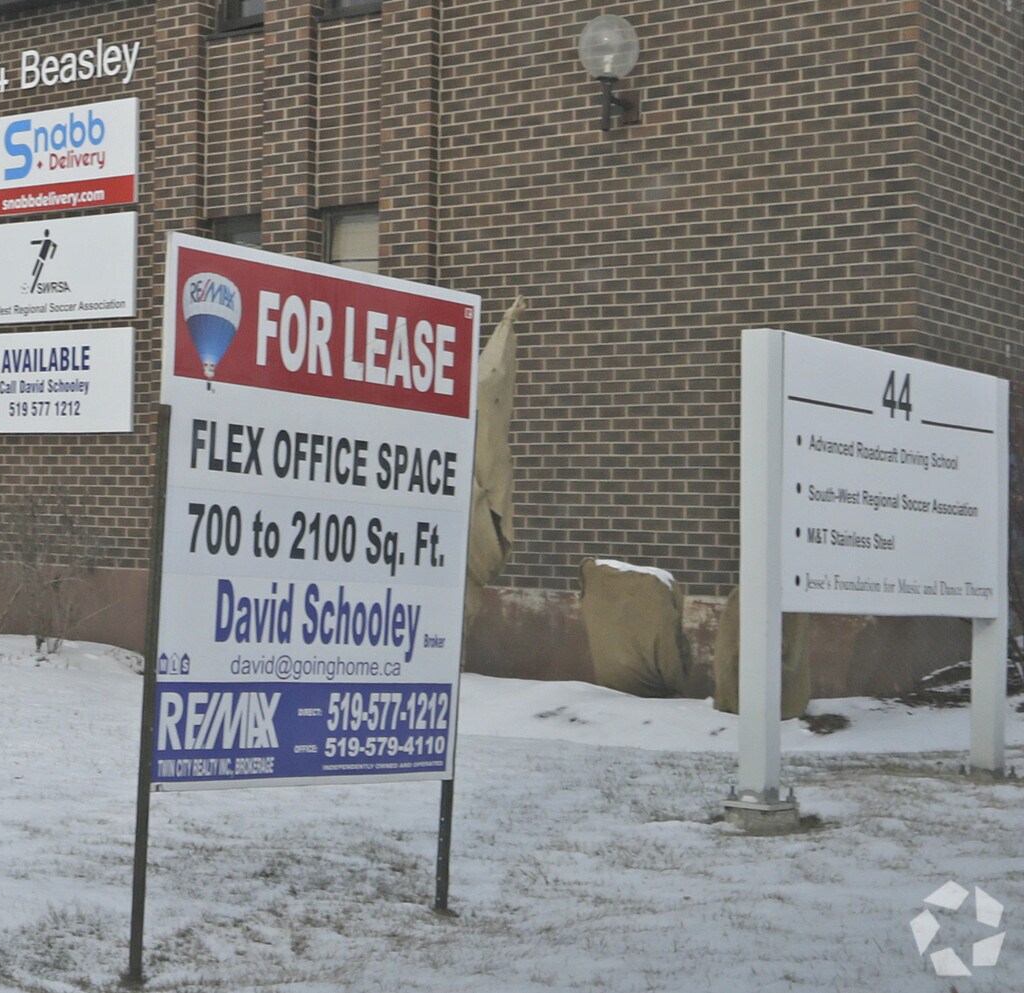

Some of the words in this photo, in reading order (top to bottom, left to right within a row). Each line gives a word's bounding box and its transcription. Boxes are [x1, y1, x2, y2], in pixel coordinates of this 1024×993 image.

[21, 38, 140, 89] Beasley
[4, 109, 105, 181] Snabb
[49, 150, 106, 170] Delivery
[2, 189, 105, 210] snabbdelivery.com
[37, 281, 71, 294] SWRSA
[13, 302, 47, 316] Regional
[49, 301, 76, 313] Soccer
[78, 299, 126, 312] Association
[256, 290, 333, 377] FOR
[344, 306, 456, 396] LEASE
[1, 346, 91, 373] AVAILABLE
[0, 379, 17, 394] Call
[20, 379, 44, 393] David
[47, 378, 90, 395] Schooley
[882, 370, 912, 421] 44
[9, 401, 28, 417] 519
[31, 401, 51, 416] 577
[55, 400, 81, 416] 1212
[190, 419, 264, 476] FLEX
[273, 429, 368, 487] OFFICE
[376, 442, 457, 496] SPACE
[808, 434, 854, 458] Advanced
[856, 441, 898, 464] Roadcraft
[900, 447, 929, 470] Driving
[931, 452, 959, 470] School
[808, 484, 860, 505] South-West
[862, 490, 900, 511] Regional
[901, 494, 931, 511] Soccer
[932, 498, 979, 517] Association
[188, 503, 241, 556] 700
[253, 509, 280, 558] to
[289, 511, 357, 563] 2100
[366, 517, 405, 577] Sq.
[414, 521, 444, 567] Ft.
[807, 527, 828, 544] M&T
[830, 529, 871, 549] Stainless
[873, 533, 895, 550] Steel
[834, 575, 880, 593] Foundation
[883, 577, 897, 593] for
[898, 578, 921, 594] Music
[923, 580, 938, 595] and
[940, 581, 963, 596] Dance
[965, 582, 993, 600] Therapy
[214, 579, 295, 644] David
[302, 583, 421, 663] Schooley
[424, 634, 446, 648] Broker
[230, 654, 401, 680] david@goinghome.ca
[157, 692, 282, 751] RE/MAX
[327, 692, 449, 731] 519-577-1212
[324, 735, 446, 758] 519-579-4110
